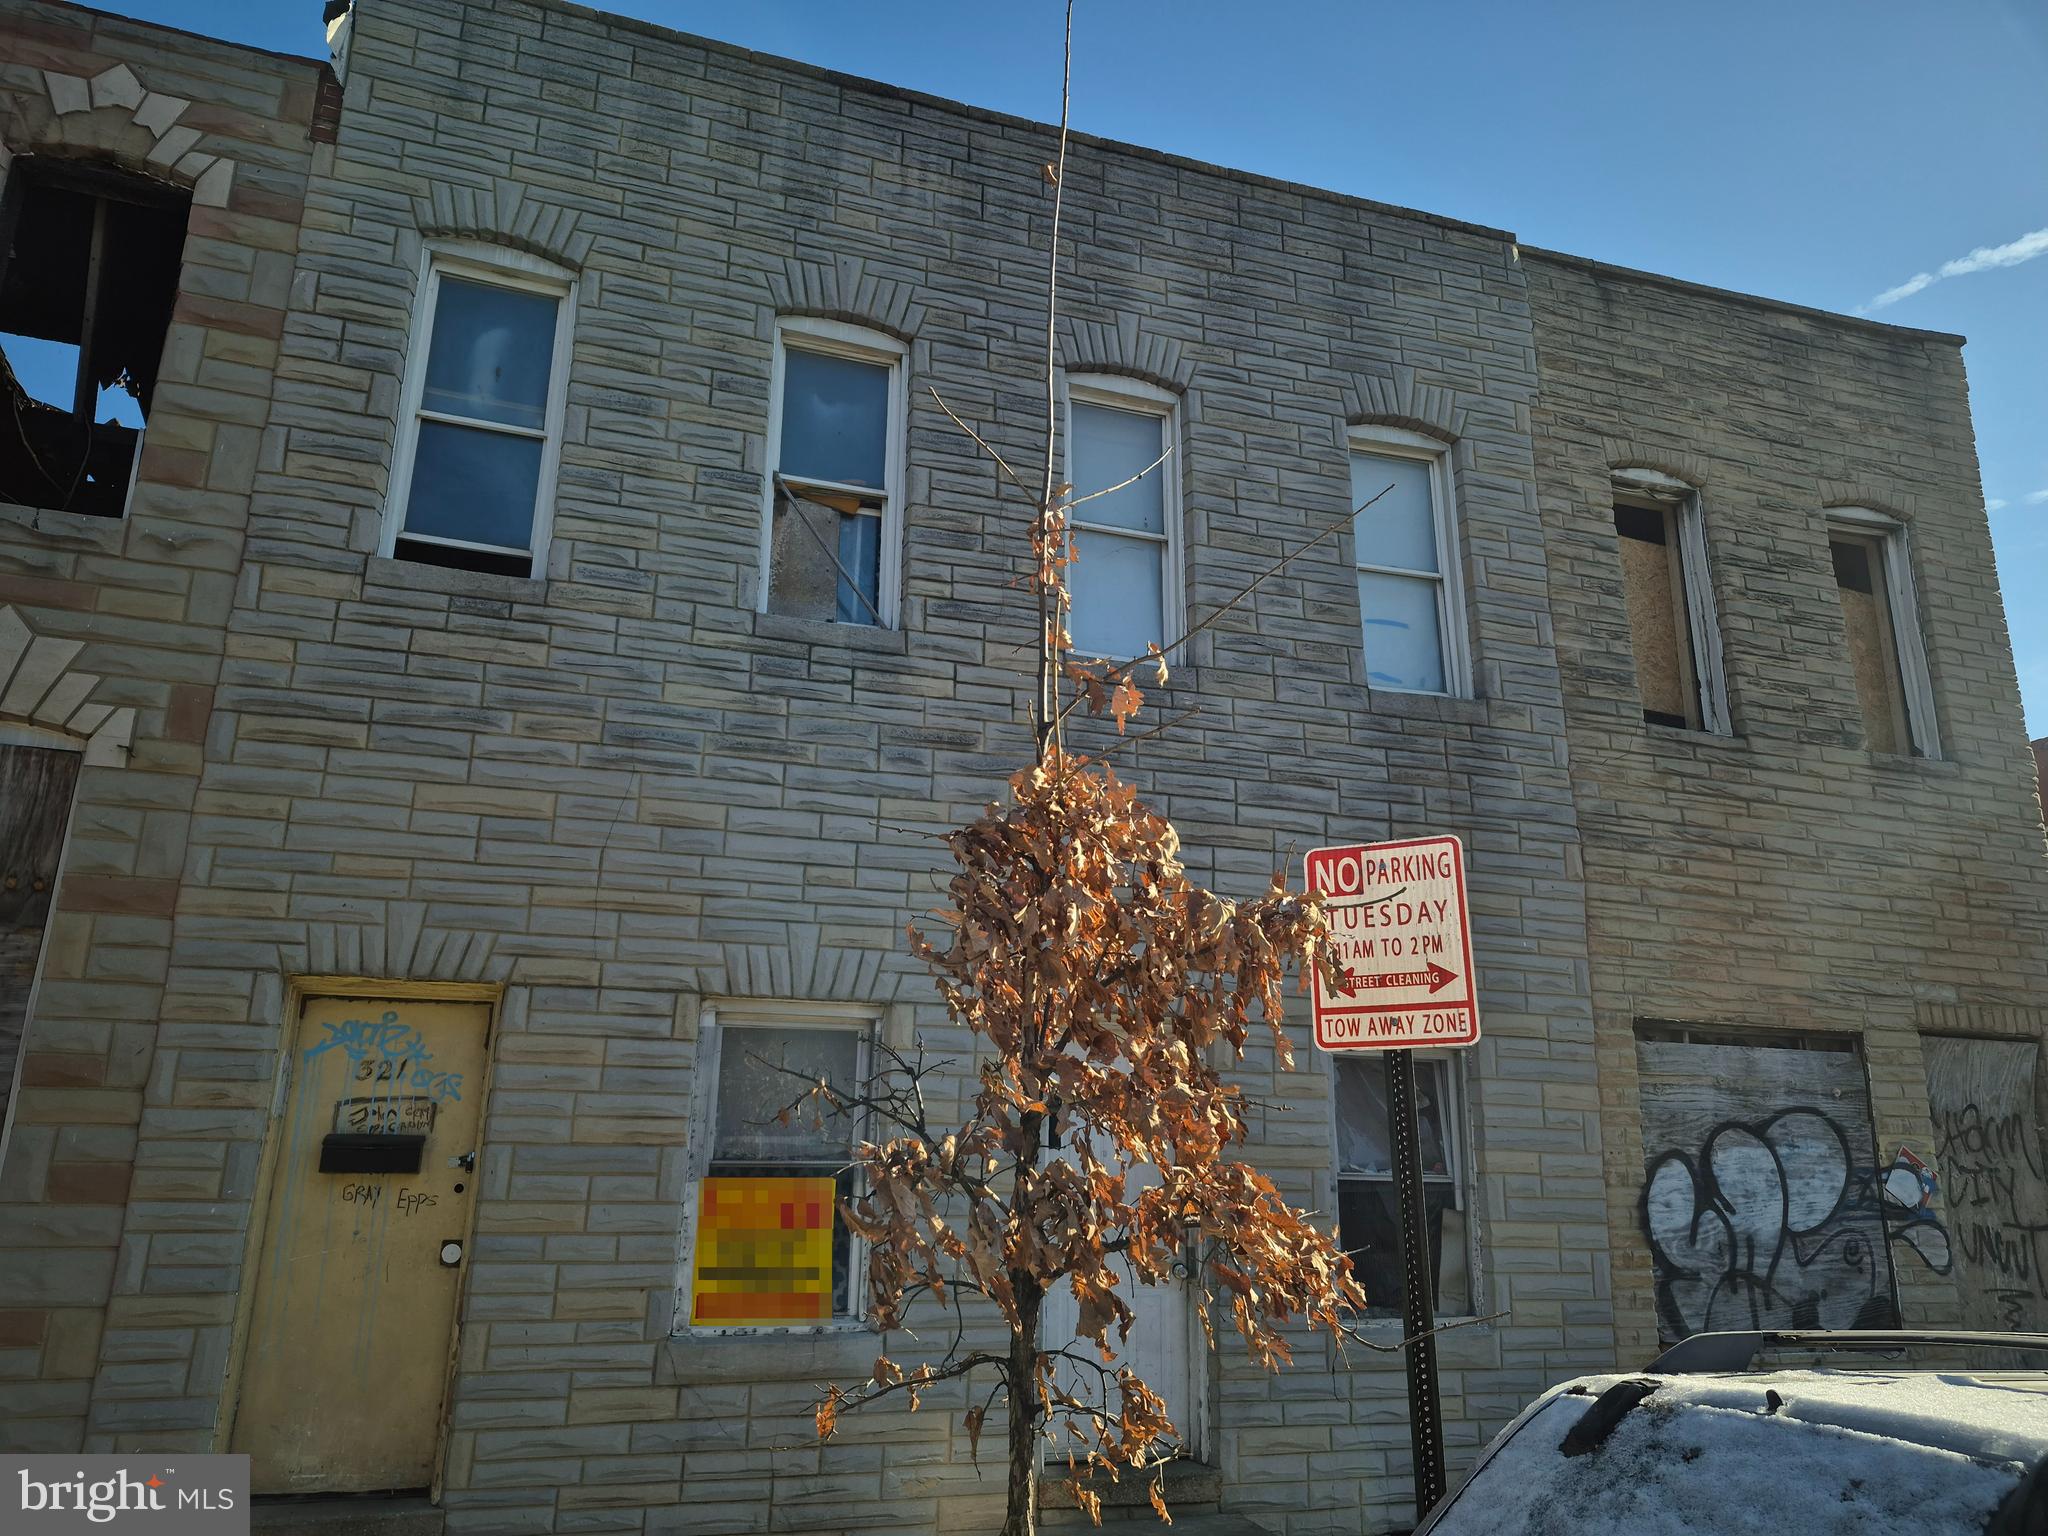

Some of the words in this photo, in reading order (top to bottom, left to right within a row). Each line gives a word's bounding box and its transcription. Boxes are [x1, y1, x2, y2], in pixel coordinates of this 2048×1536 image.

[1315, 856, 1360, 893] NO
[1366, 851, 1451, 885] PARKING
[1325, 899, 1448, 931] TUESDAY
[1380, 937, 1402, 957] TO
[1385, 972, 1440, 986] CLEANING
[1325, 1017, 1361, 1038] TOW
[1367, 1014, 1415, 1036] AWAY
[1423, 1012, 1467, 1034] ZONE
[355, 1058, 408, 1081] 321
[342, 1183, 382, 1208] GRAY
